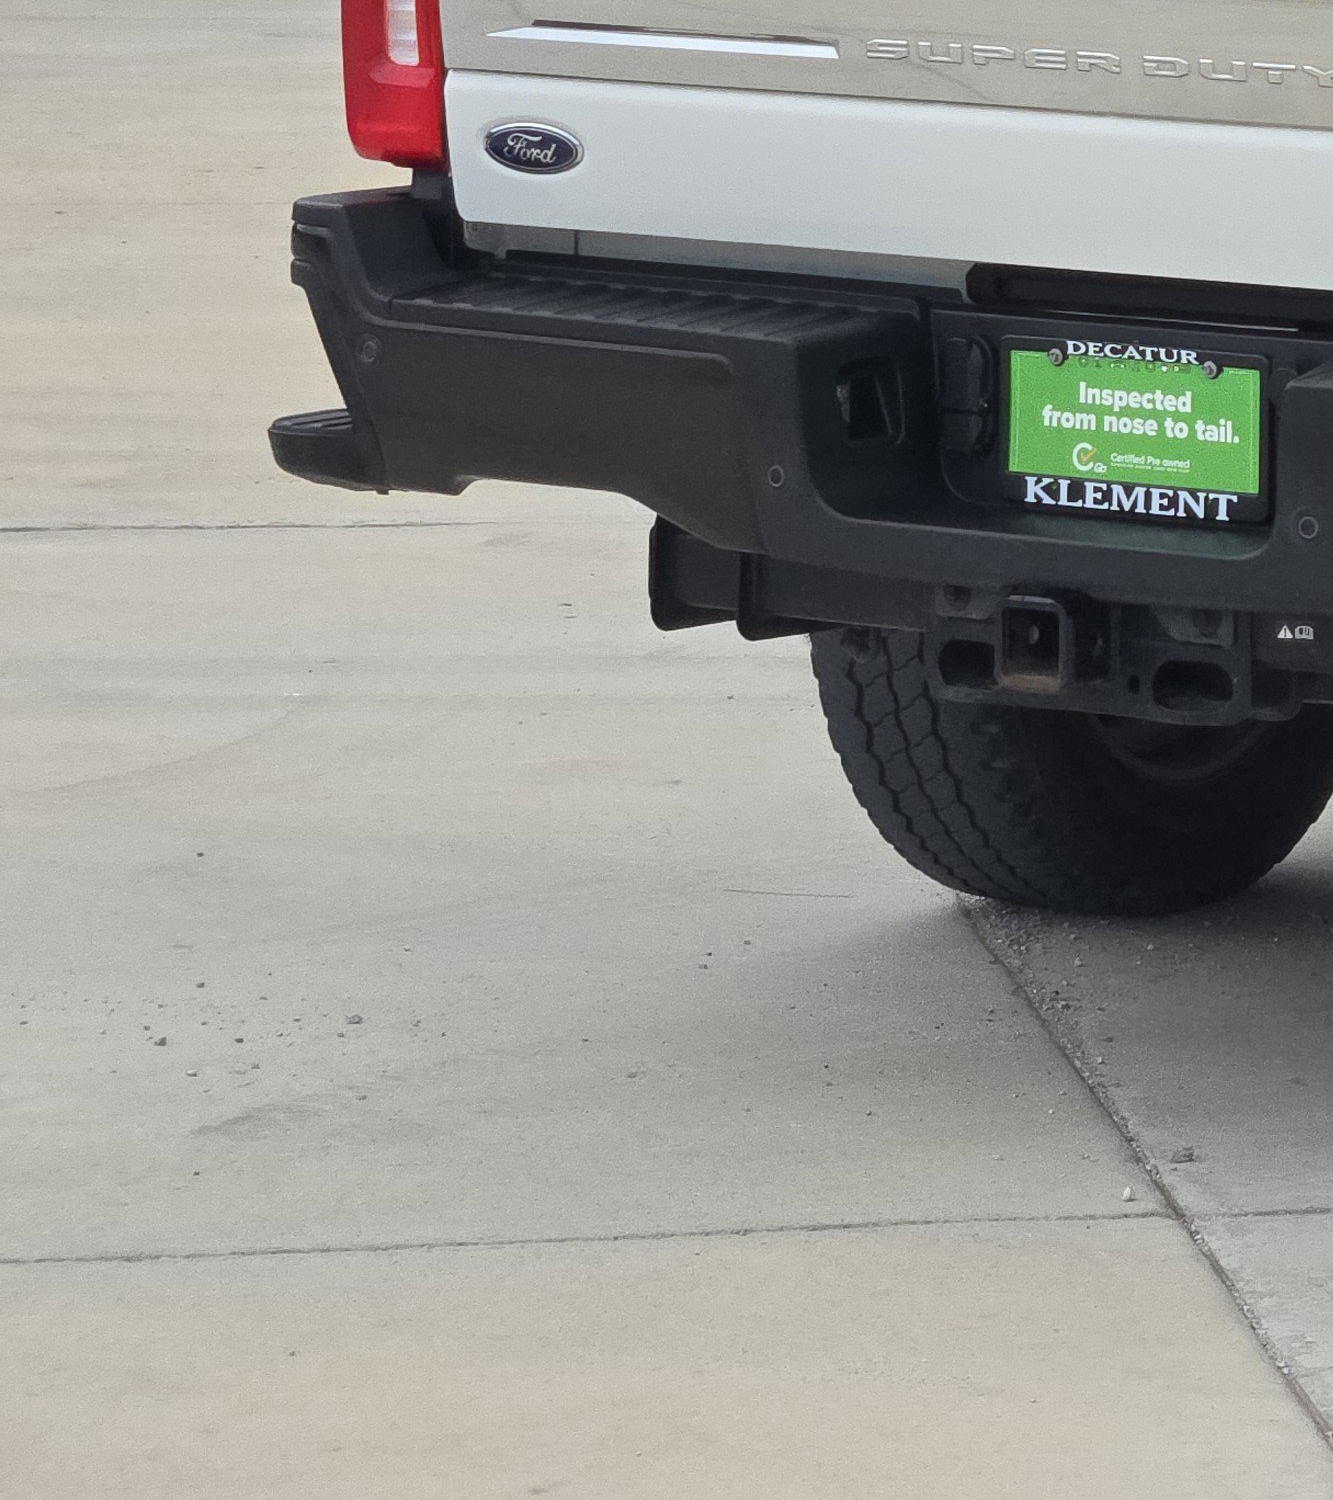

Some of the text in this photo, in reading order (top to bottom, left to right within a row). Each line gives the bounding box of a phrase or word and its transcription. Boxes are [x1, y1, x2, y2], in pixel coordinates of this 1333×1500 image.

[866, 38, 1122, 75] SUPER
[502, 132, 557, 163] Ford
[1066, 340, 1199, 365] DECATUR
[1078, 381, 1192, 413] Inspected
[1042, 405, 1240, 444] from nose to tail.
[1024, 476, 1238, 521] KLEMENT
